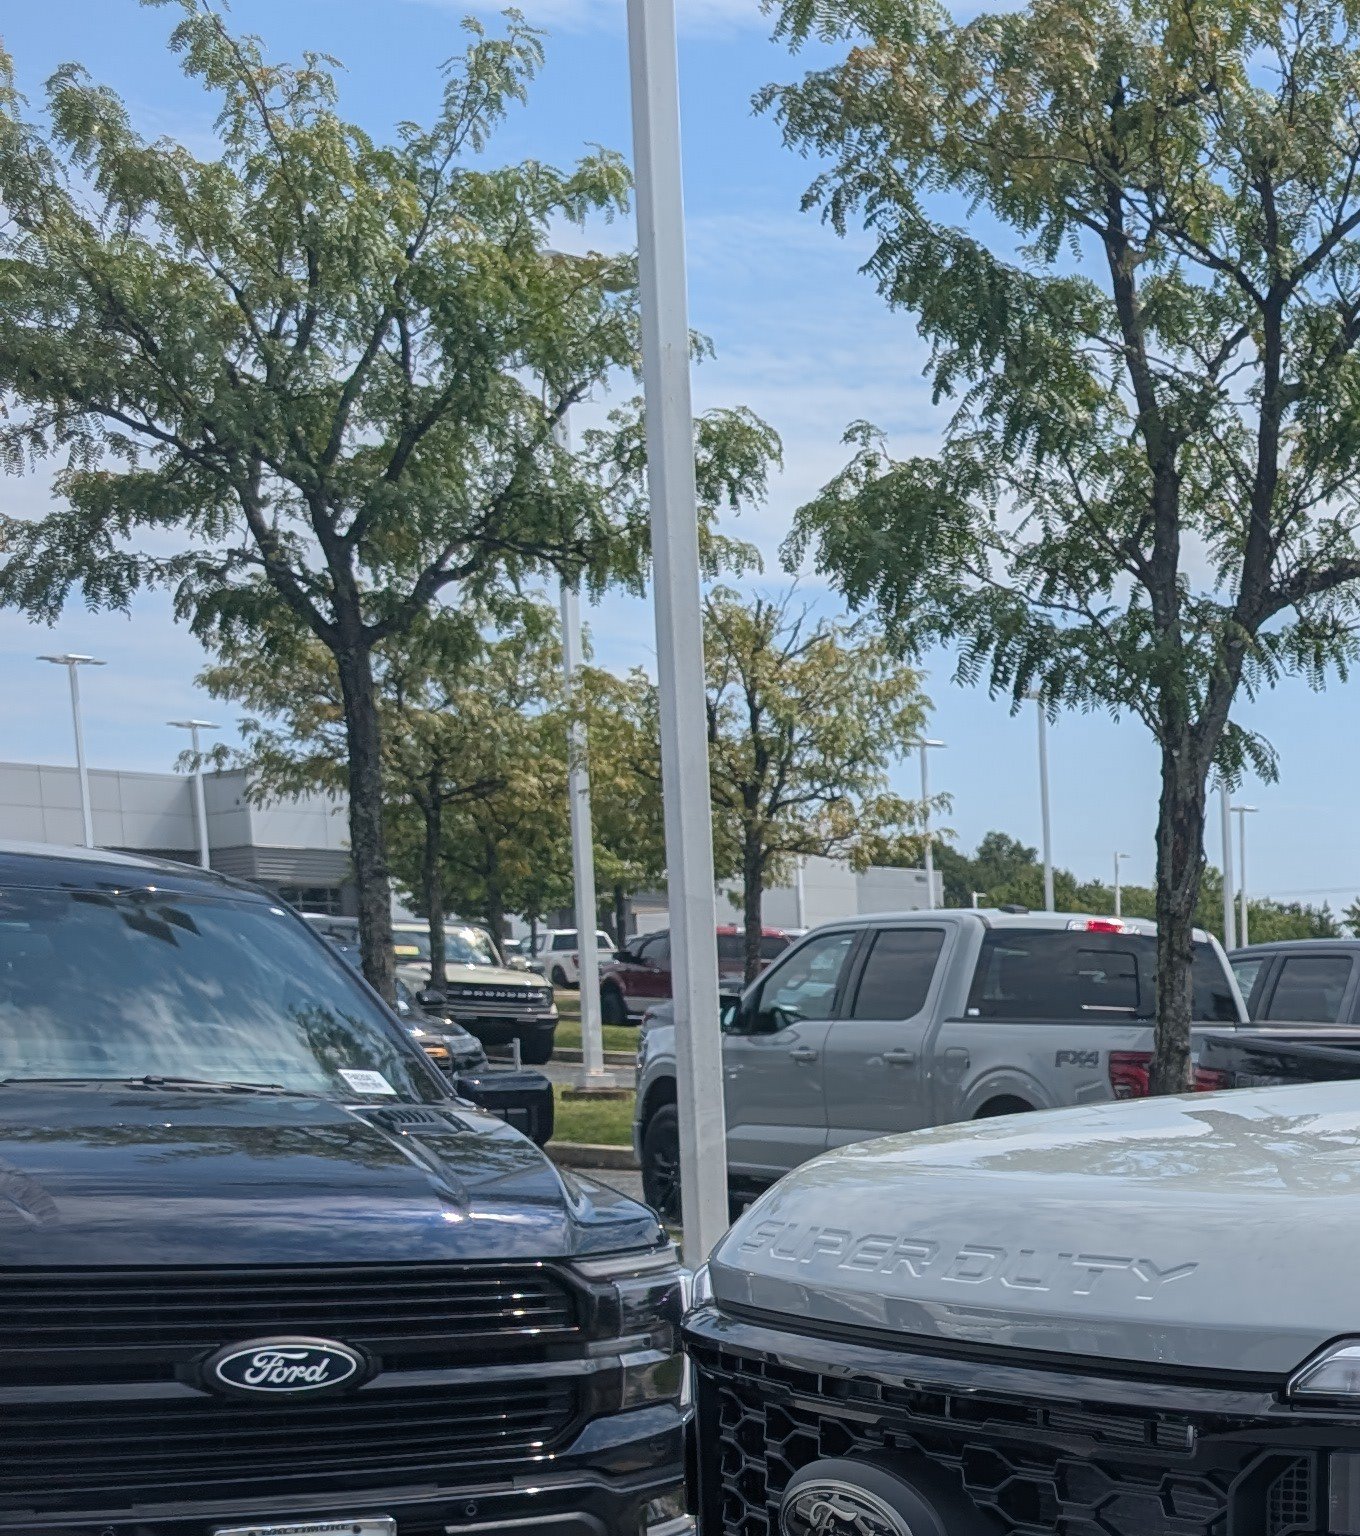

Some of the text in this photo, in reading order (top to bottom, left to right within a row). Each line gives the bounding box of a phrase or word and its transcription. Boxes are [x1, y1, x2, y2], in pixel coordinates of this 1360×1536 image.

[1055, 1050, 1099, 1068] FX4
[738, 1219, 1200, 1300] SUPER DUTY
[244, 1351, 331, 1385] Ford
